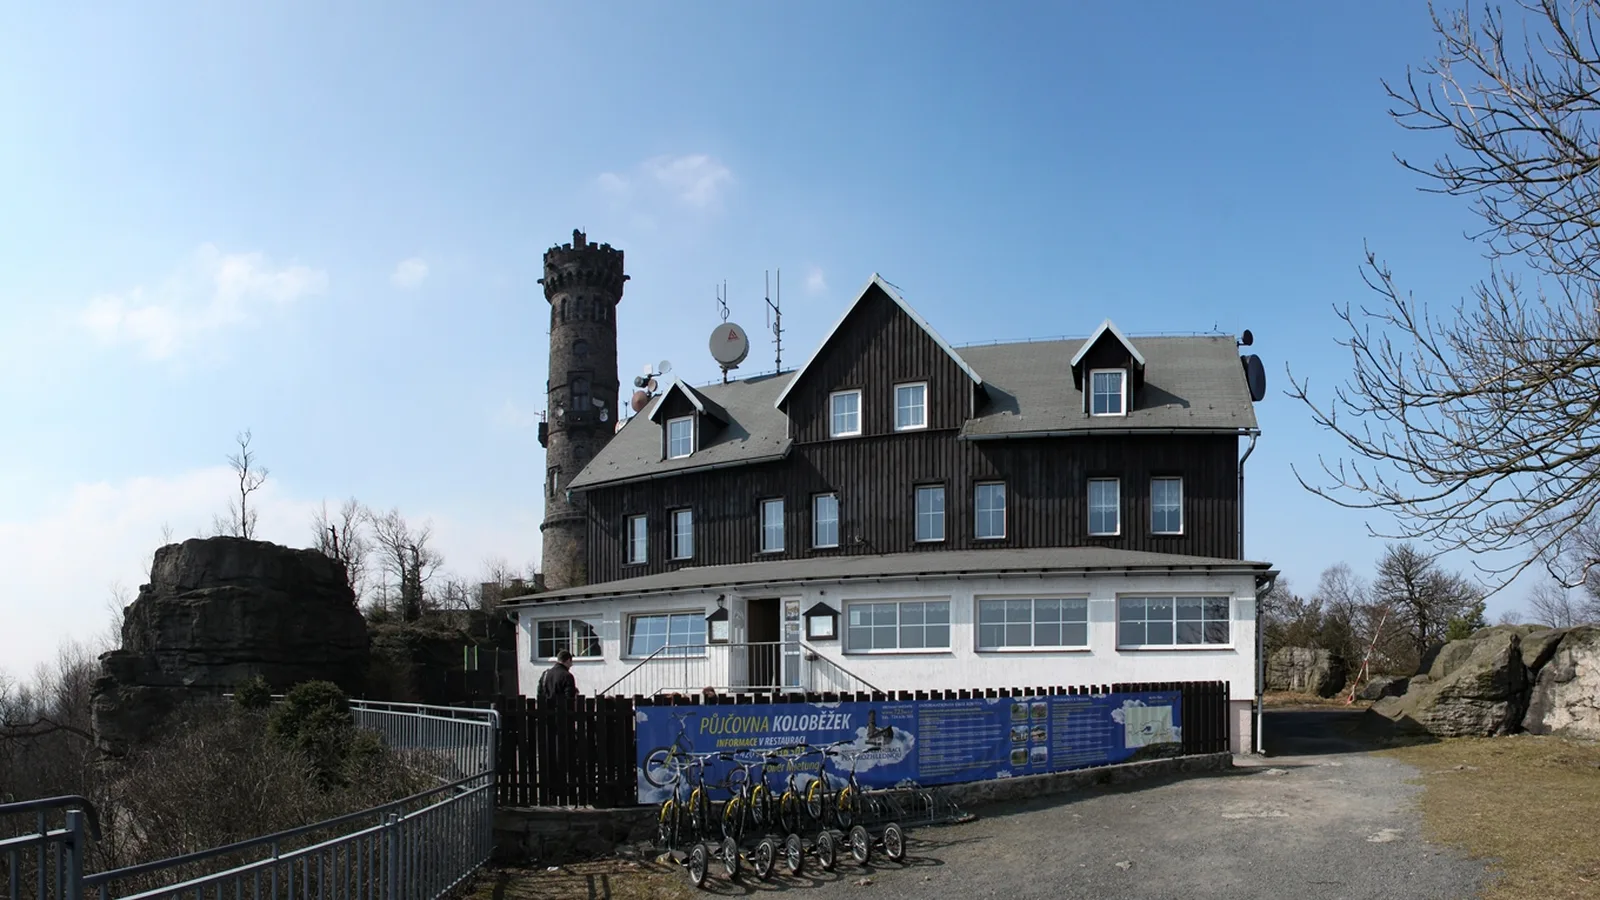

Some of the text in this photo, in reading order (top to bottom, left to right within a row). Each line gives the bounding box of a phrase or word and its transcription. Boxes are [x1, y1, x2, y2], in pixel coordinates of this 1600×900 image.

[700, 710, 852, 735] PŮJČOVNA KOLOBĚŽEK
[716, 735, 806, 748] INFORMACE V RESTAURACI
